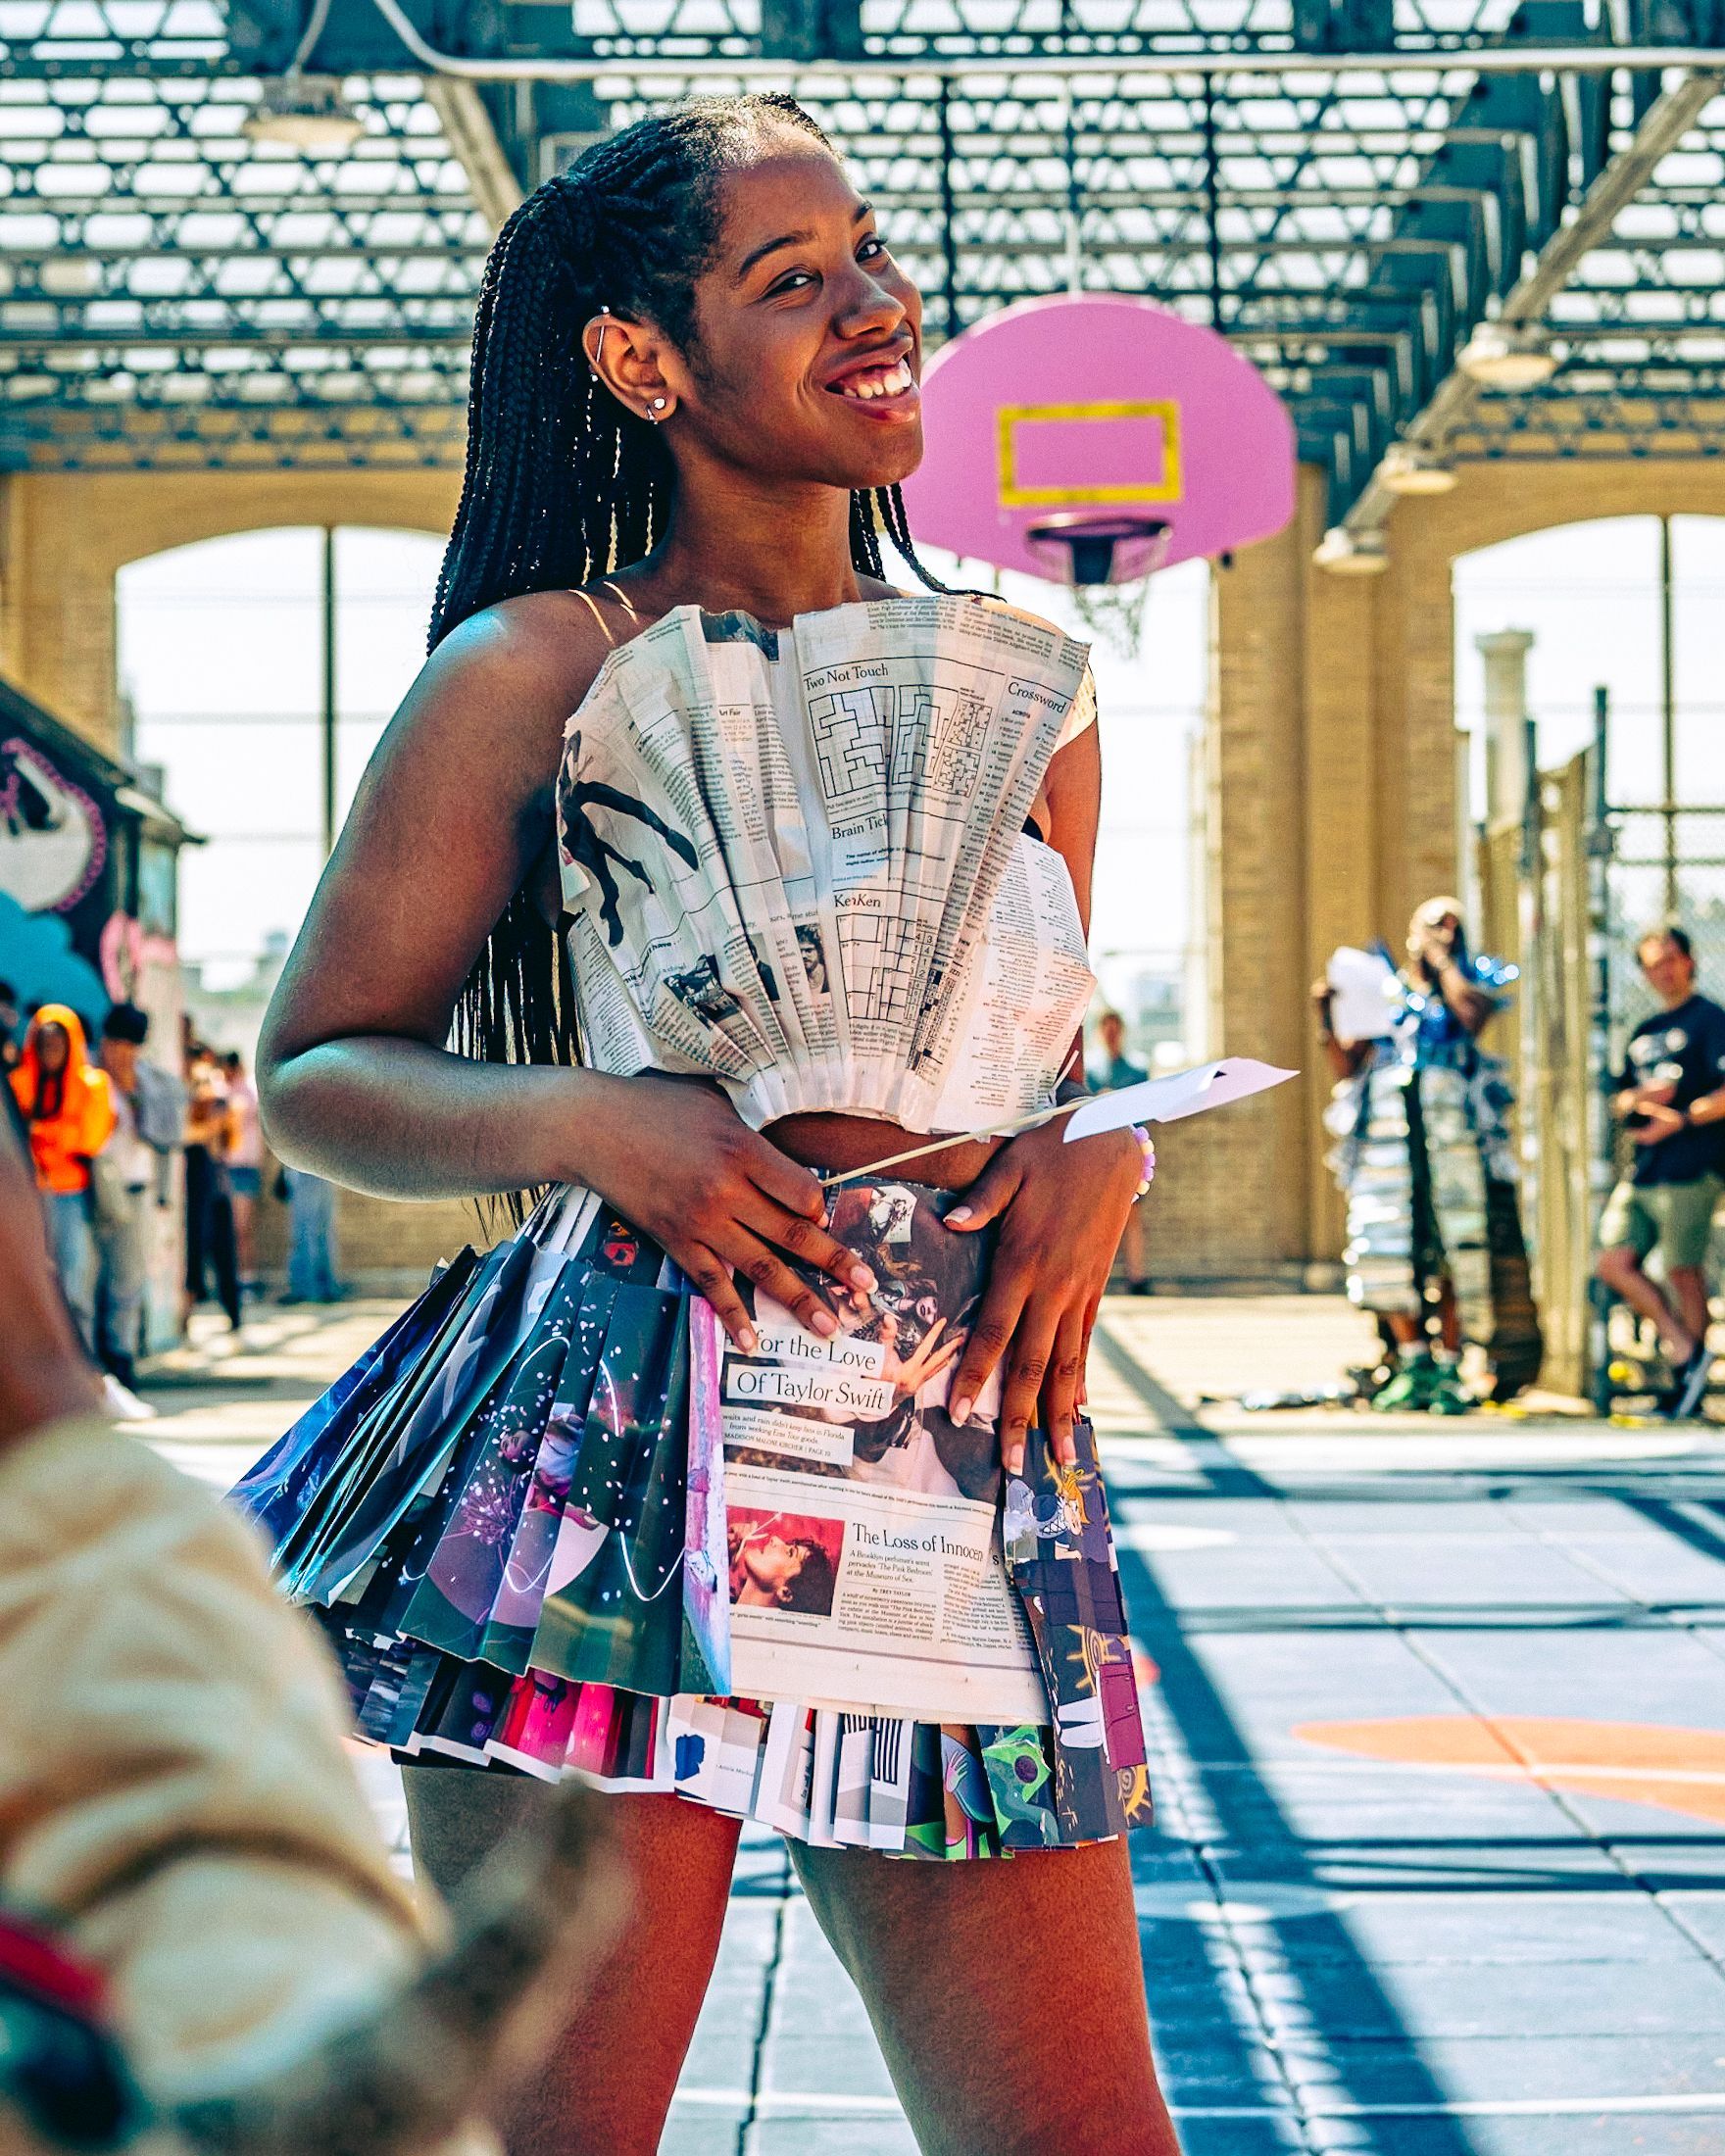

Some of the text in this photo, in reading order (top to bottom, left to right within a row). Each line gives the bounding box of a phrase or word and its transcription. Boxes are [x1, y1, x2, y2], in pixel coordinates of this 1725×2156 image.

[804, 664, 888, 692] Two Not Touch
[1009, 681, 1066, 713] Crossword
[832, 821, 864, 839] Brain
[790, 1336, 821, 1359] the
[829, 1341, 876, 1370] Love
[738, 1372, 885, 1409] Of Taylor Swift
[823, 1429, 844, 1441] Florida
[853, 1522, 879, 1544] The
[883, 1529, 918, 1549] Loss
[922, 1536, 936, 1551] of
[941, 1537, 983, 1562] Innocen
[858, 1550, 883, 1561] Brooklyn
[865, 1571, 893, 1580] Museum
[892, 1564, 905, 1573] Pink
